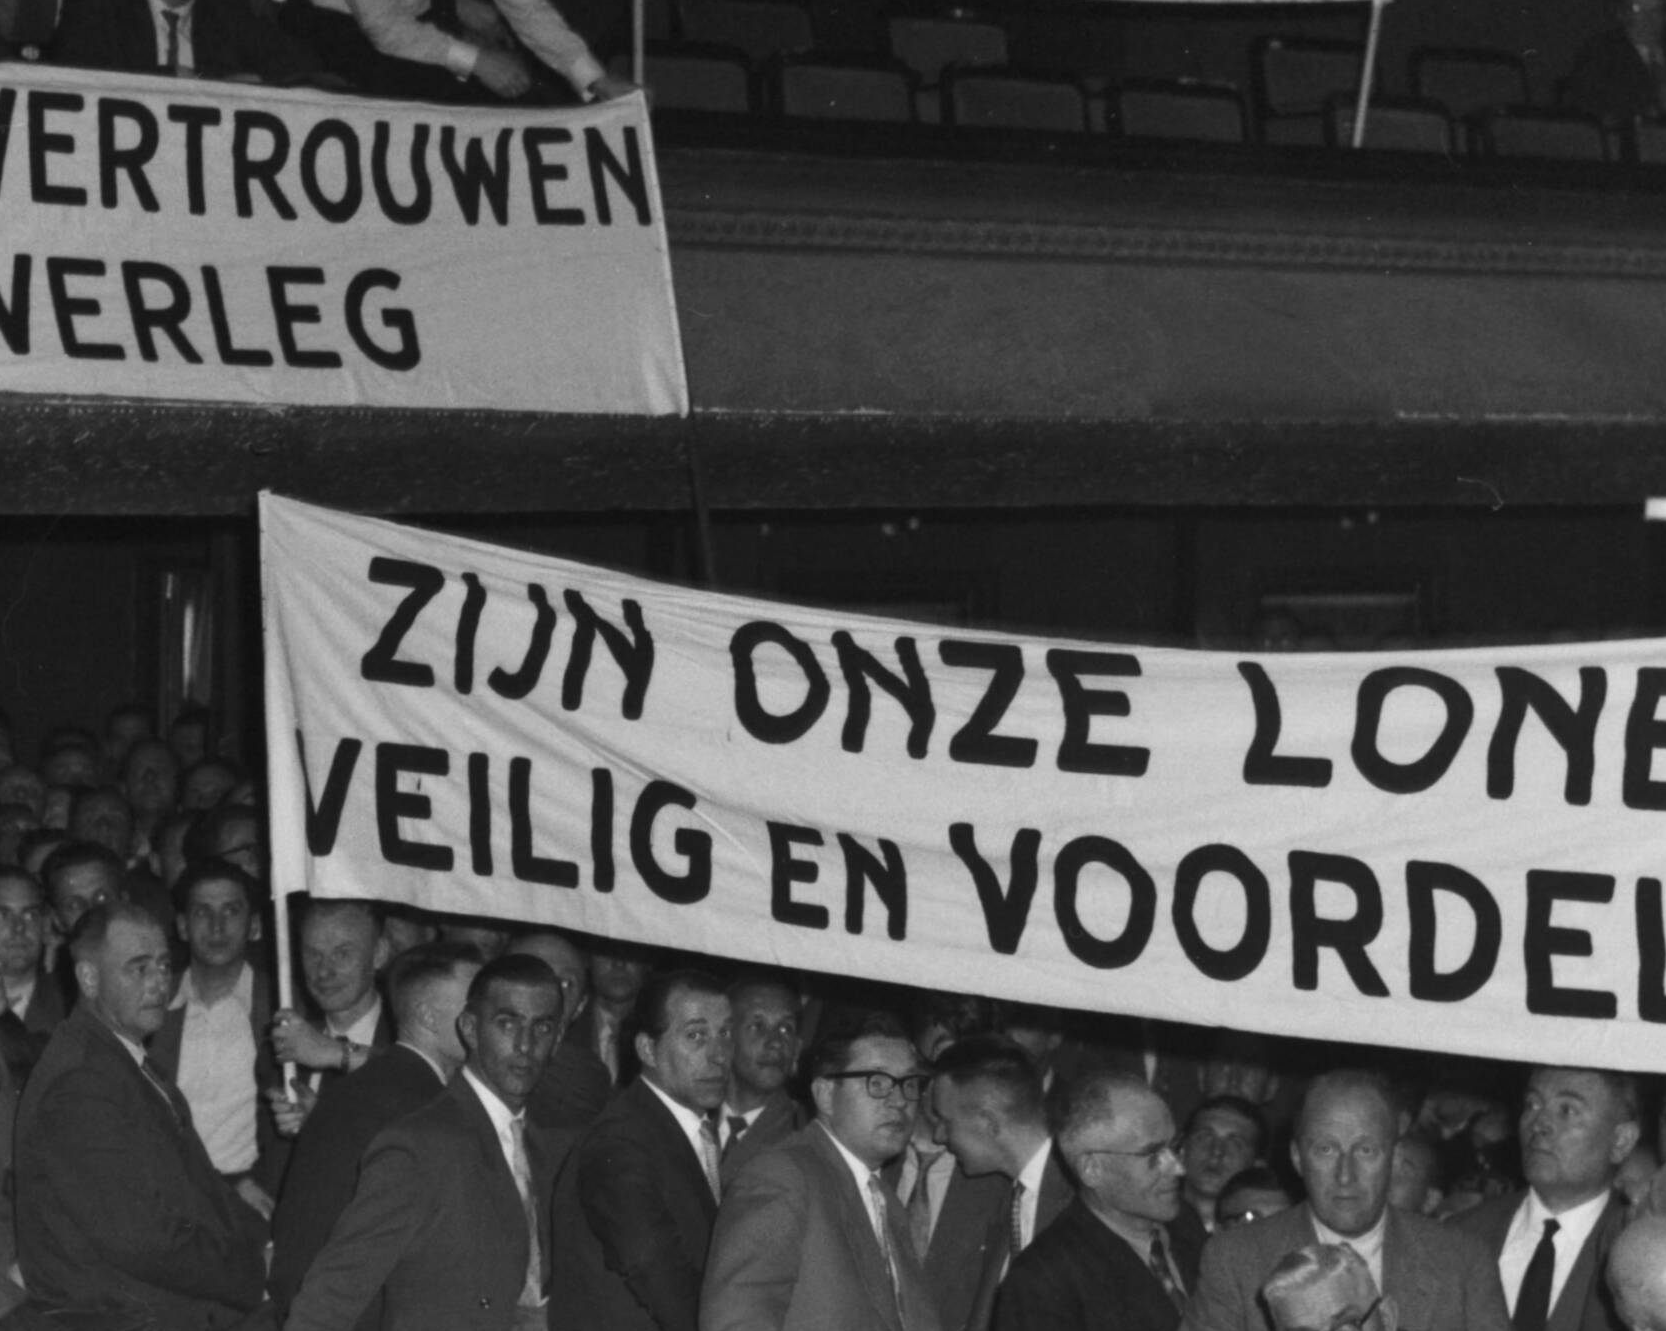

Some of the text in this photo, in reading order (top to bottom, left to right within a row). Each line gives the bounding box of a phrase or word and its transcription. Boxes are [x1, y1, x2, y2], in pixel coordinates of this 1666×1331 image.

[360, 556, 656, 721] ZIJN
[729, 620, 1151, 777] ONZE
[295, 727, 713, 906] VEILIG
[766, 820, 908, 941] EN
